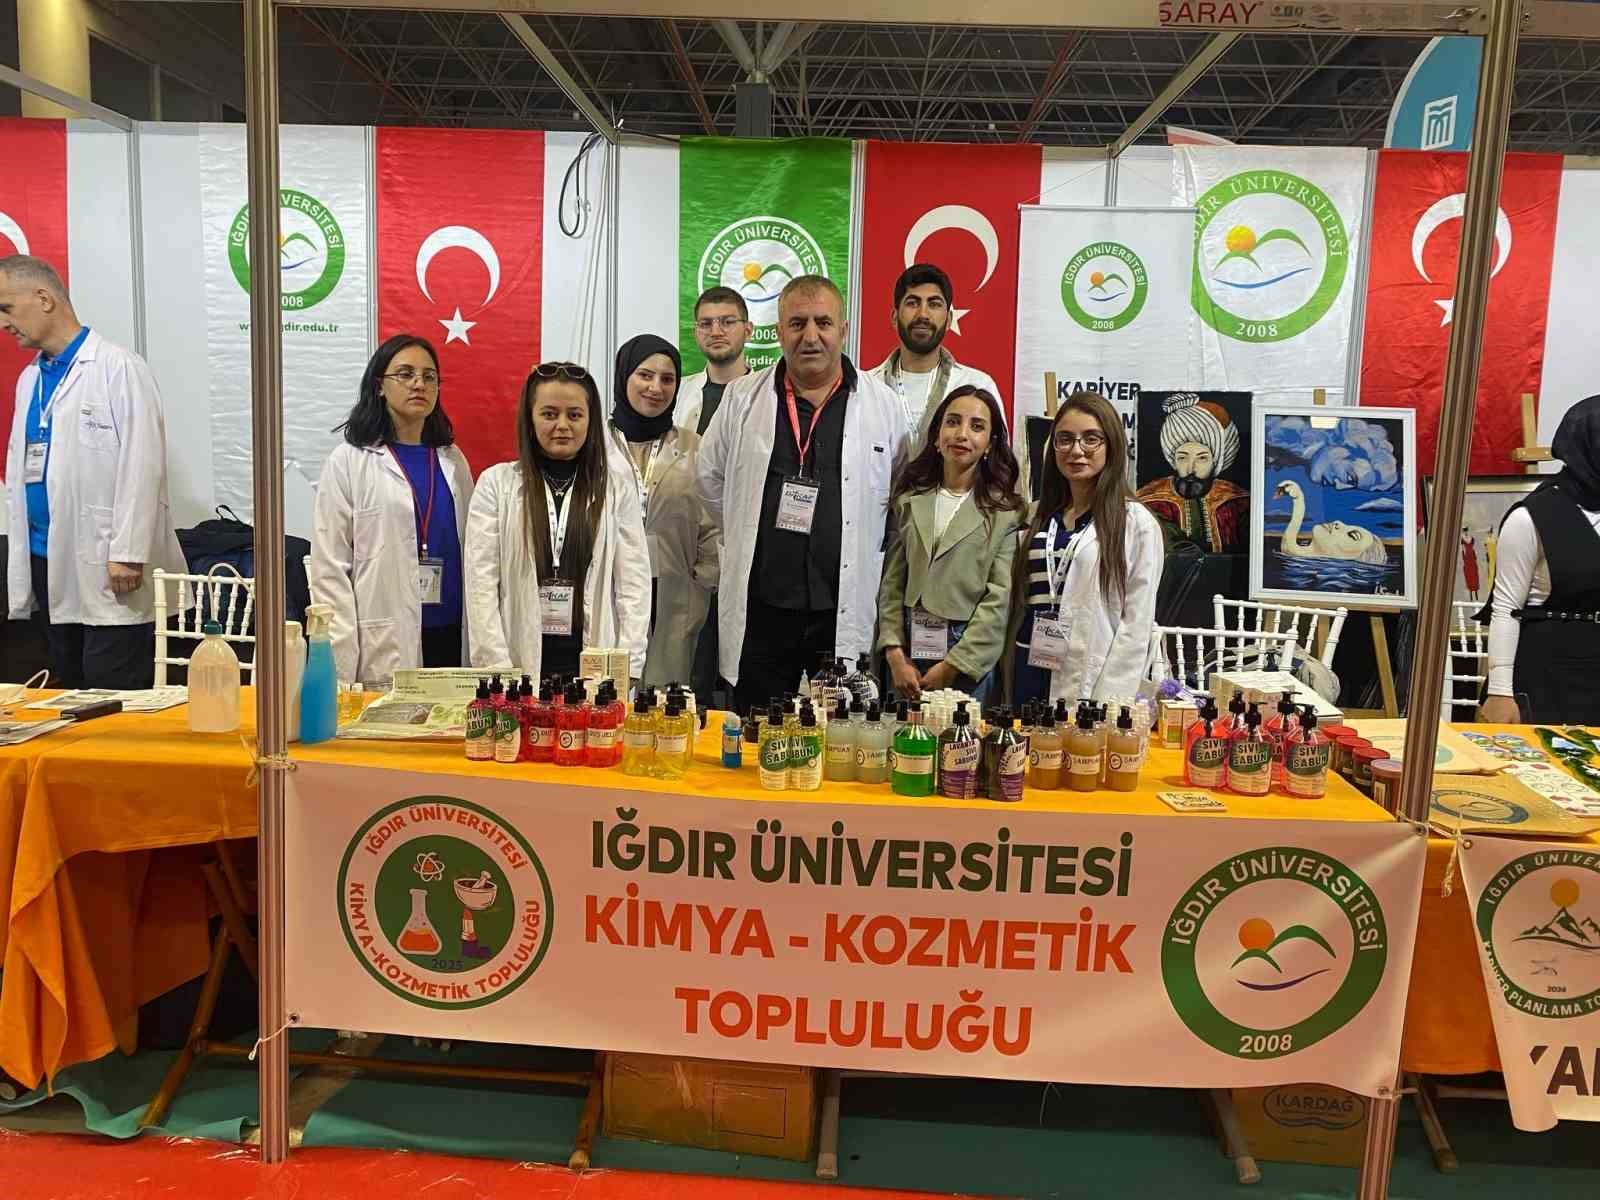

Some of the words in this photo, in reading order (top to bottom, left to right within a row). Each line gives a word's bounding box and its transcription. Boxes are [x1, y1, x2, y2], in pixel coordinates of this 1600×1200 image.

[706, 239, 734, 279] IĞDIR
[735, 222, 819, 275] ÜNİVERSİTES
[281, 295, 304, 307] 008
[1092, 320, 1114, 329] 2008
[1235, 322, 1279, 338] 2008
[1057, 376, 1141, 400] KARİYER
[365, 815, 407, 856] IĞDIR
[409, 804, 529, 870] ÜNİVERSİTESİ
[592, 806, 737, 881] IĞDIR
[750, 818, 1133, 897] ÜNİVERSİTESİ
[1171, 877, 1227, 945] IĞDIR
[1230, 850, 1384, 952] ÜNİVERSİTESİ
[475, 899, 541, 994] TOPLULUĞU
[584, 882, 775, 958] KİMYA
[788, 935, 809, 949] -
[824, 906, 1137, 974] KOZMETİK
[431, 959, 464, 971] 2025
[674, 987, 1032, 1056] TOPLULUĞU
[1509, 990, 1584, 1017] PLANLAMA
[1239, 1034, 1293, 1054] 2008
